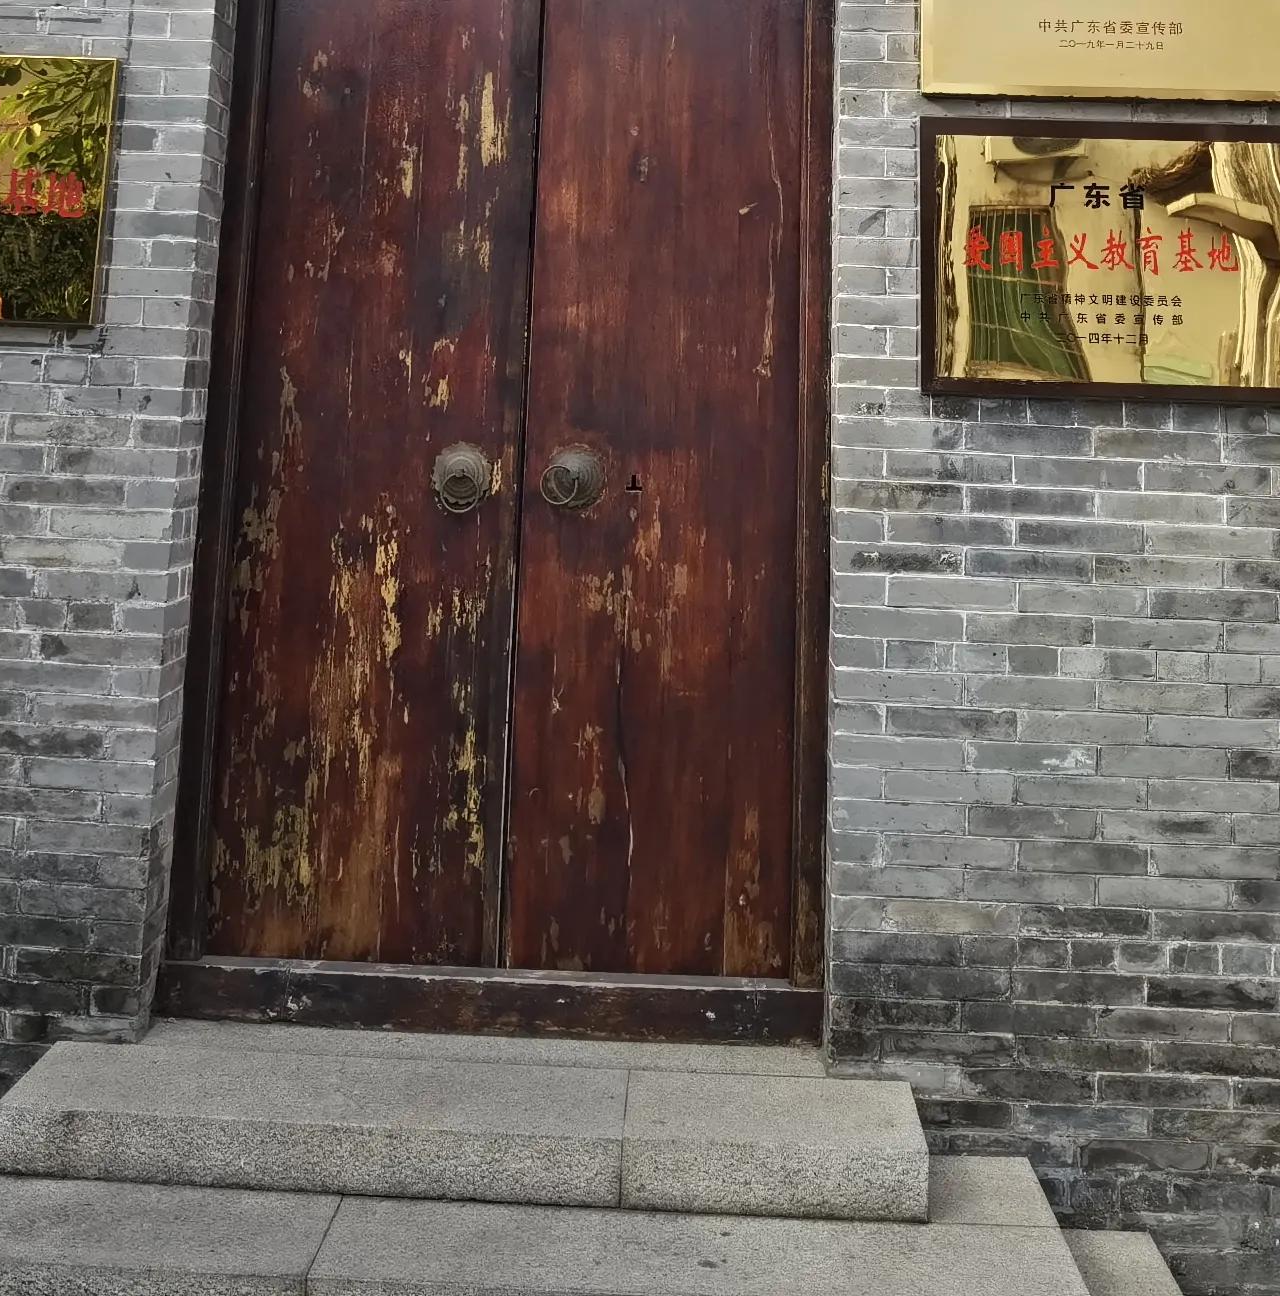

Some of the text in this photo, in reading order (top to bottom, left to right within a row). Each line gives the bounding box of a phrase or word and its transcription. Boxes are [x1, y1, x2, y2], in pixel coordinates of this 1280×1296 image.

[1037, 18, 1184, 36] 中共广东省委宣传部
[1048, 182, 1146, 211] 广东省
[961, 224, 1240, 275] 爱国主义教育基地
[1019, 311, 1185, 327] 中共广东省委宣传部
